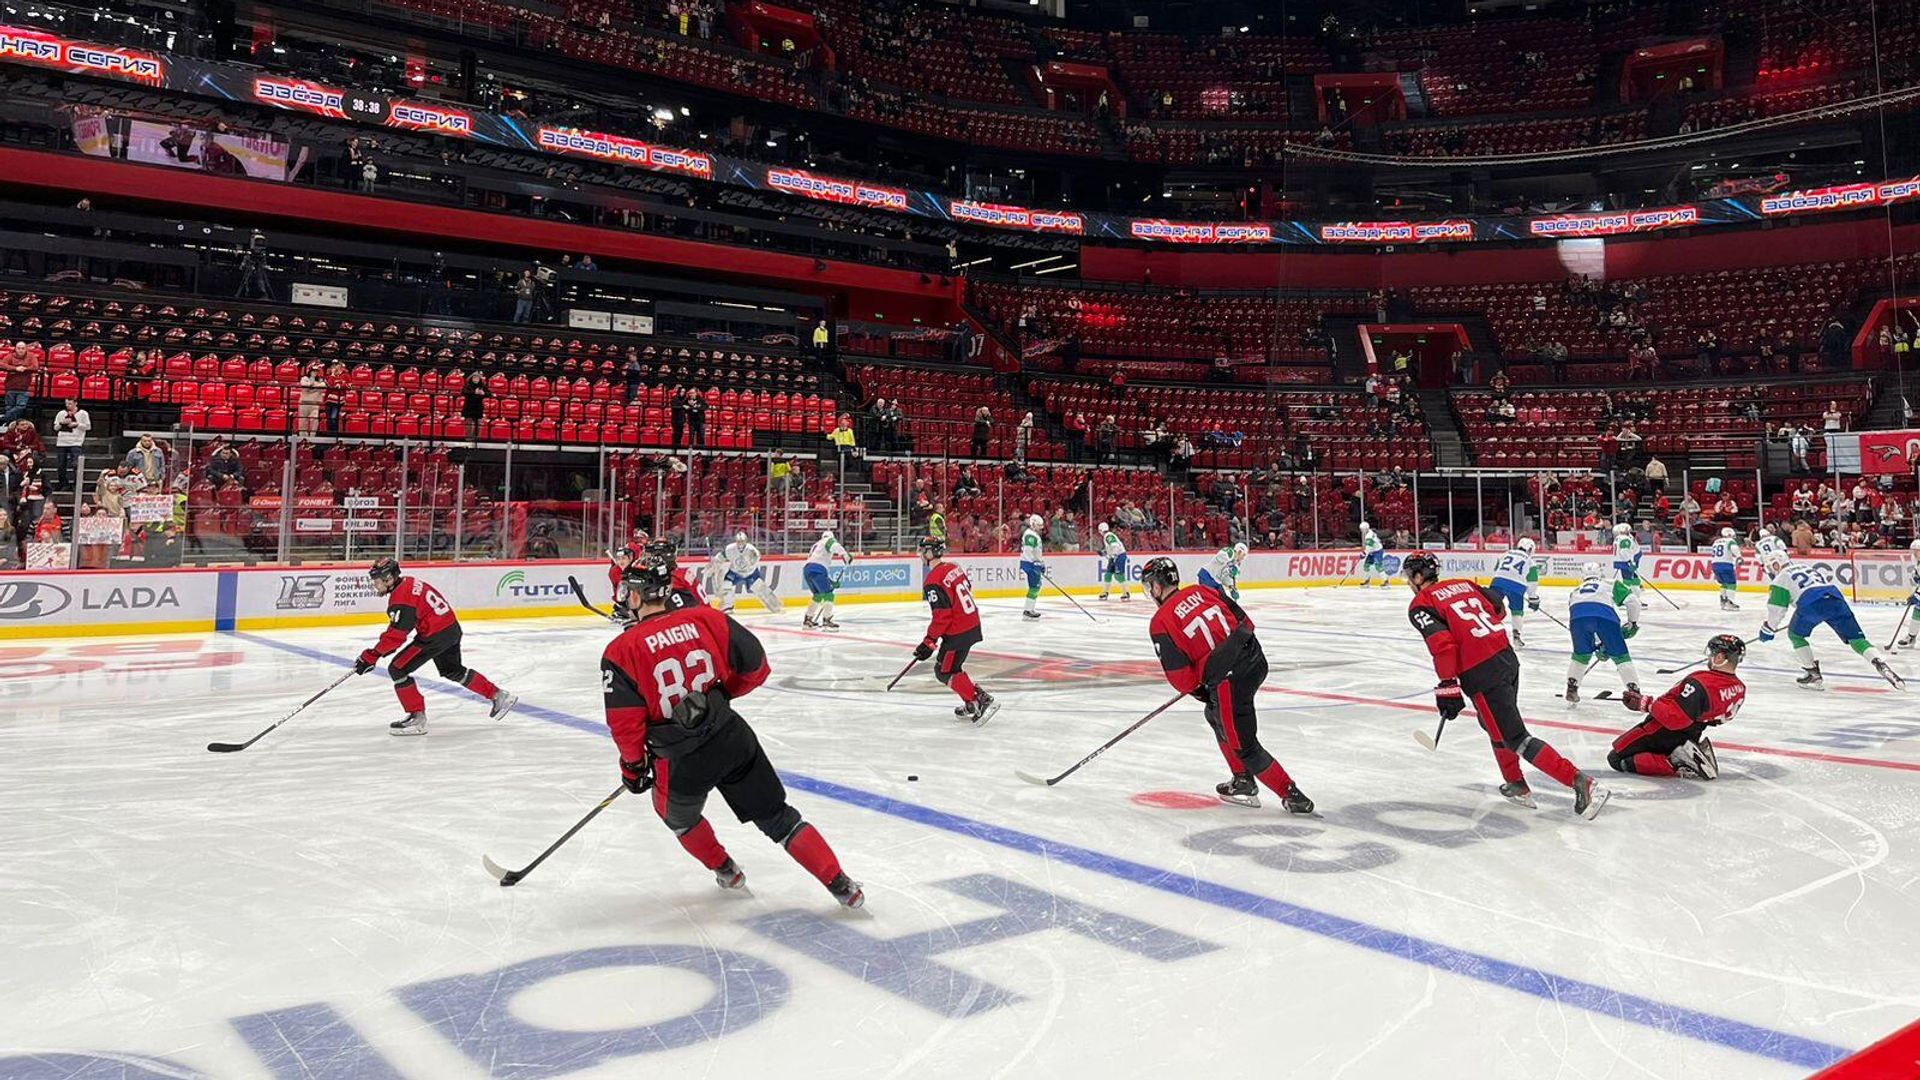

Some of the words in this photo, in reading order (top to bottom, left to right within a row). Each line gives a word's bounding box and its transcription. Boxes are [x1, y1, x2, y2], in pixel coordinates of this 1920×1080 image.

[68, 48, 158, 75] СЕРИЯ
[352, 99, 380, 115] 38:38
[394, 106, 468, 130] СЕРИЯ
[650, 150, 708, 170] СЕРИЯ
[1287, 556, 1362, 578] FONBET
[1500, 555, 1526, 575] 24
[1652, 558, 1765, 582] FONET
[82, 586, 180, 610] LADA
[1173, 591, 1205, 620] BELOV
[1182, 604, 1232, 651] 77
[1449, 597, 1506, 638] 52
[645, 622, 701, 654] PAIGIN
[602, 669, 614, 694] 2
[652, 648, 716, 719] 82
